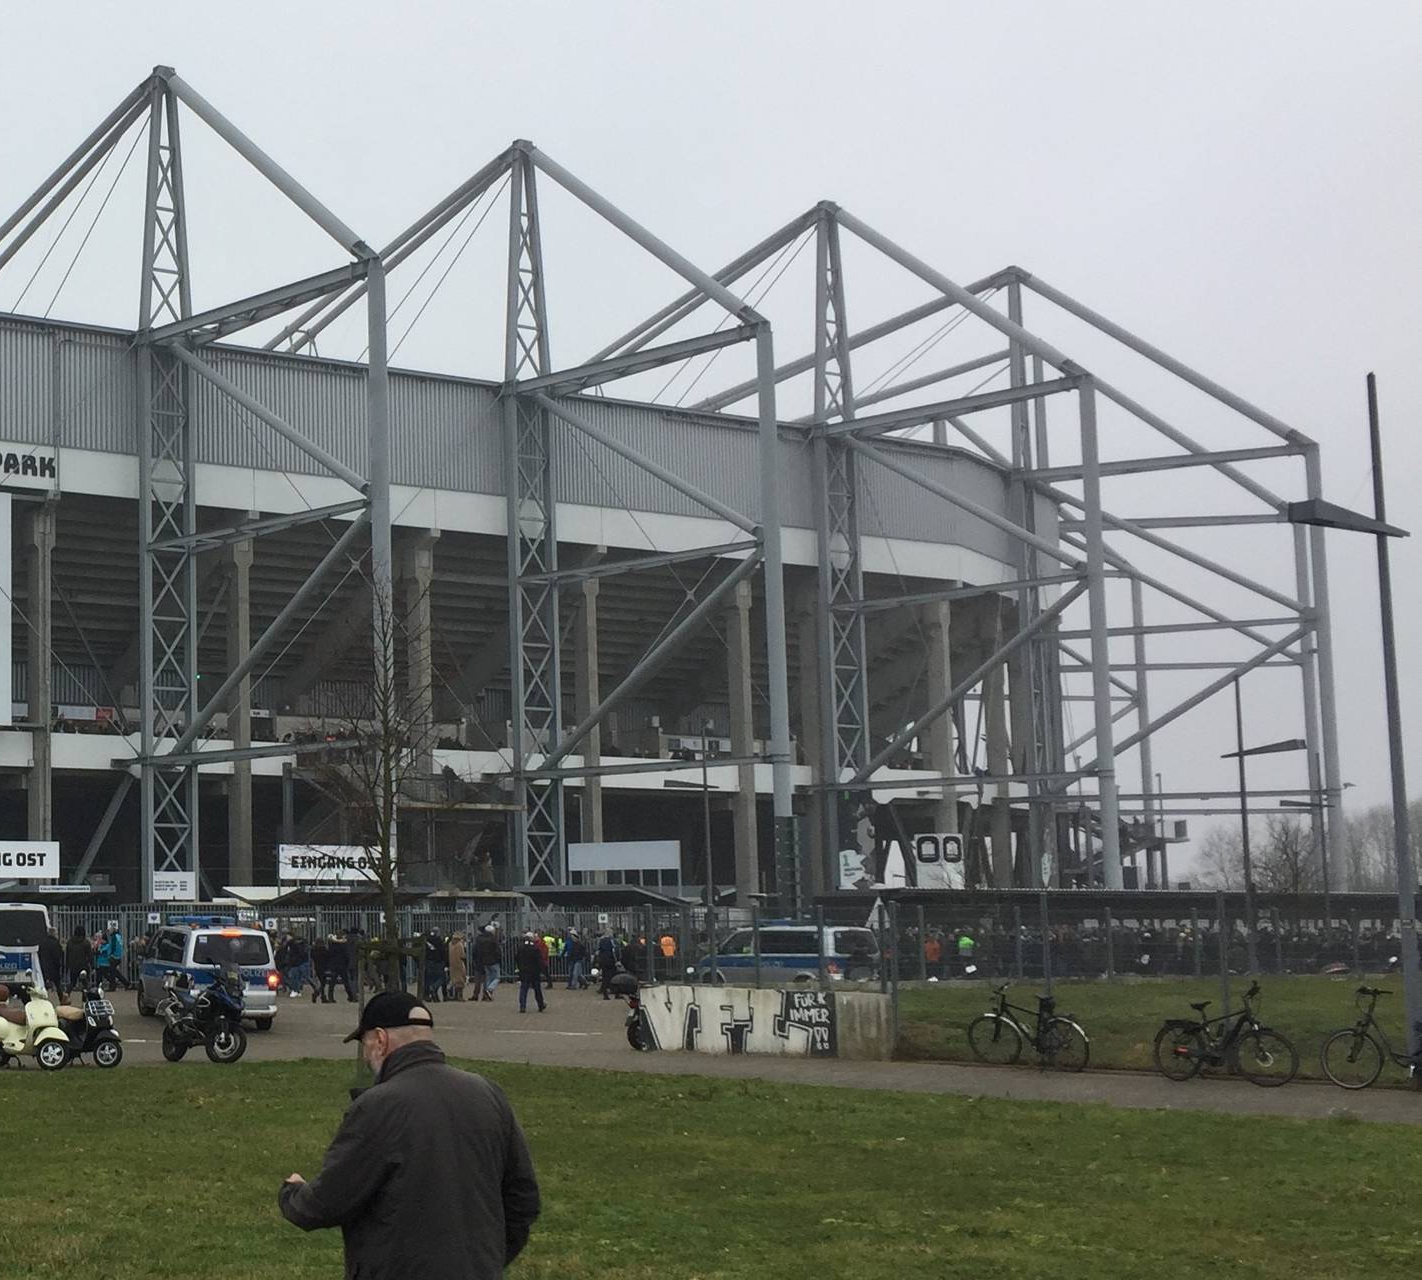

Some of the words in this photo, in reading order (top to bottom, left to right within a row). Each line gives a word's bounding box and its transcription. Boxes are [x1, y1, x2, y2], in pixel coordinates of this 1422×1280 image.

[16, 852, 47, 867] OST
[291, 855, 355, 870] EINGANG
[789, 1008, 830, 1024] IMMER
